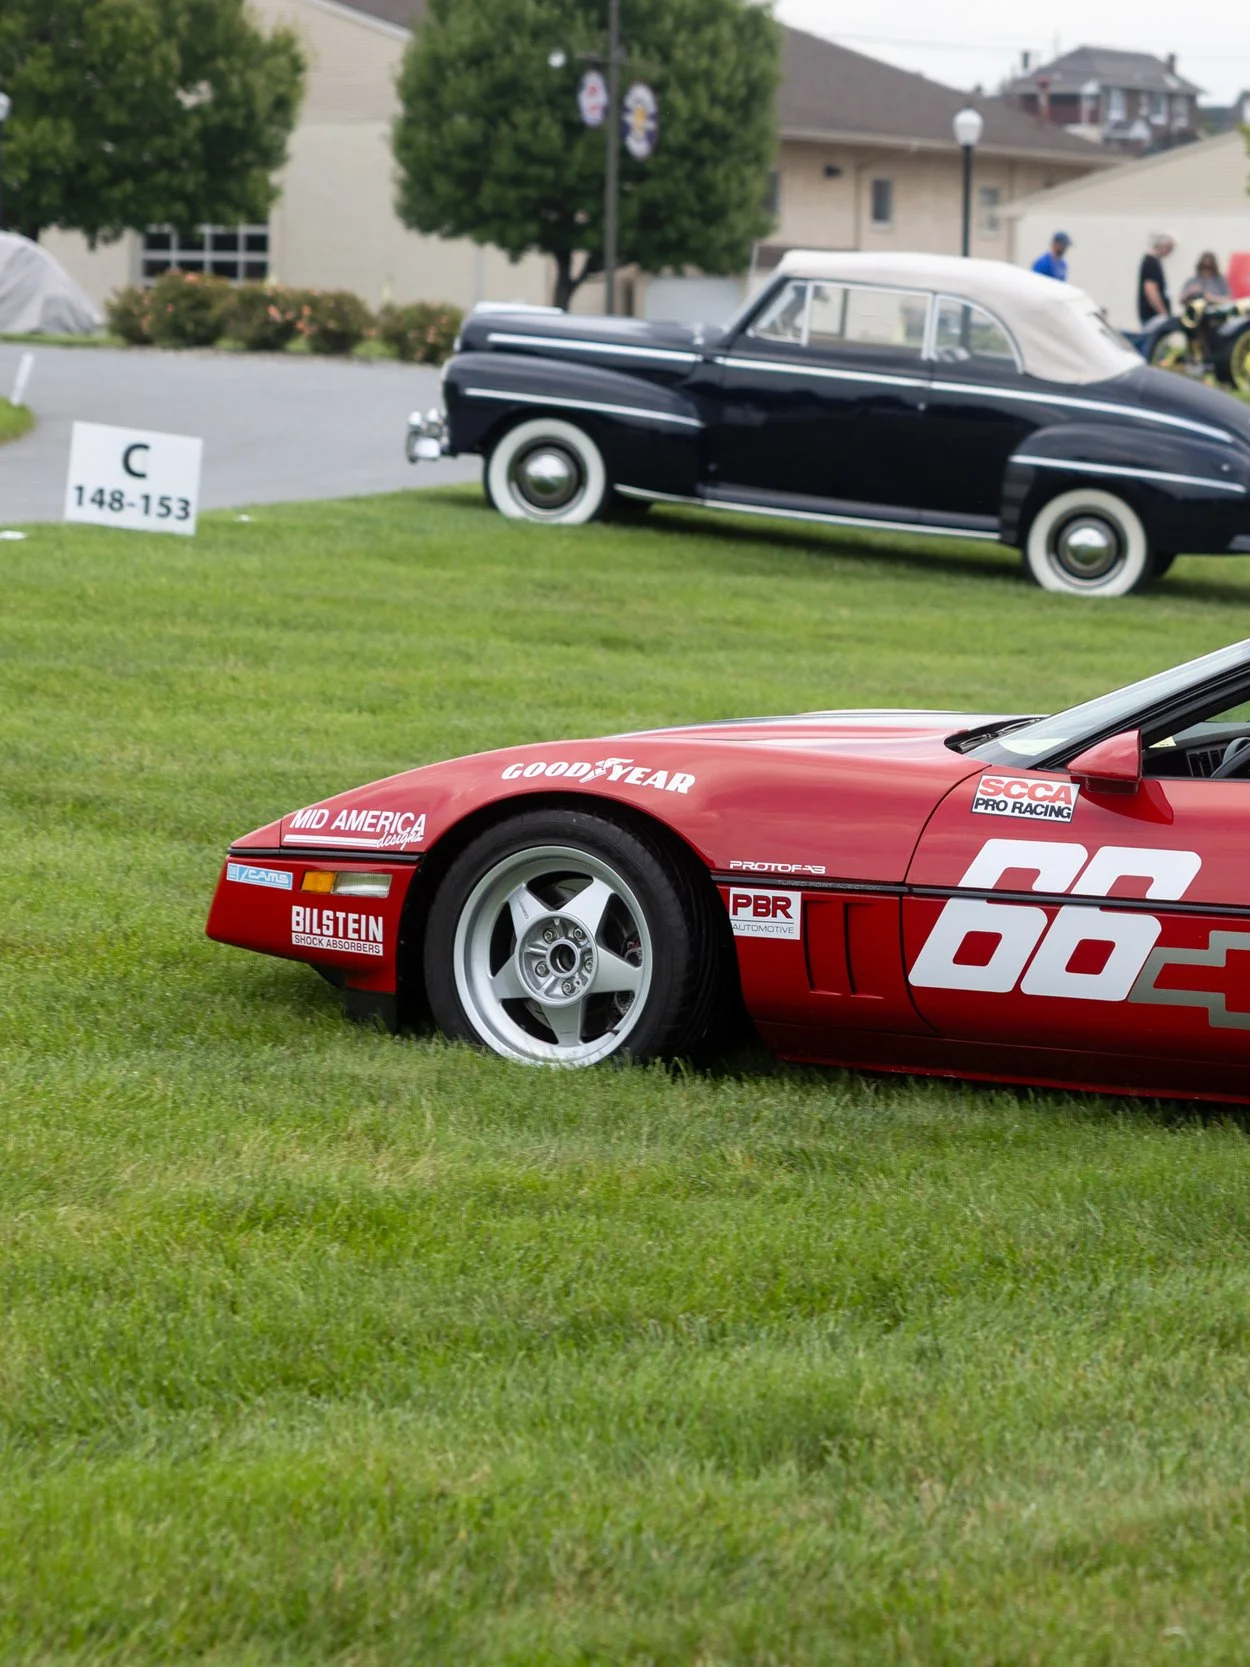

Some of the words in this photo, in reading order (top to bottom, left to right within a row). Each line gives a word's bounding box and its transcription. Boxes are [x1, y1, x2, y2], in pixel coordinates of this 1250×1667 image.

[121, 443, 151, 479] C
[74, 485, 191, 521] 148-153
[979, 778, 1073, 806] SCCA
[974, 797, 1009, 812] PRO
[1011, 801, 1072, 819] RACING
[289, 808, 330, 829] MID
[331, 809, 427, 837] AMERICA
[729, 860, 826, 874] PROTOFAB
[732, 893, 793, 919] PBR
[908, 838, 1202, 1002] 66
[291, 905, 384, 942] BILSTEIN
[732, 923, 794, 934] AUTOMOTIVE
[294, 934, 324, 947] SHOCK
[326, 939, 381, 954] ABSORBERS
